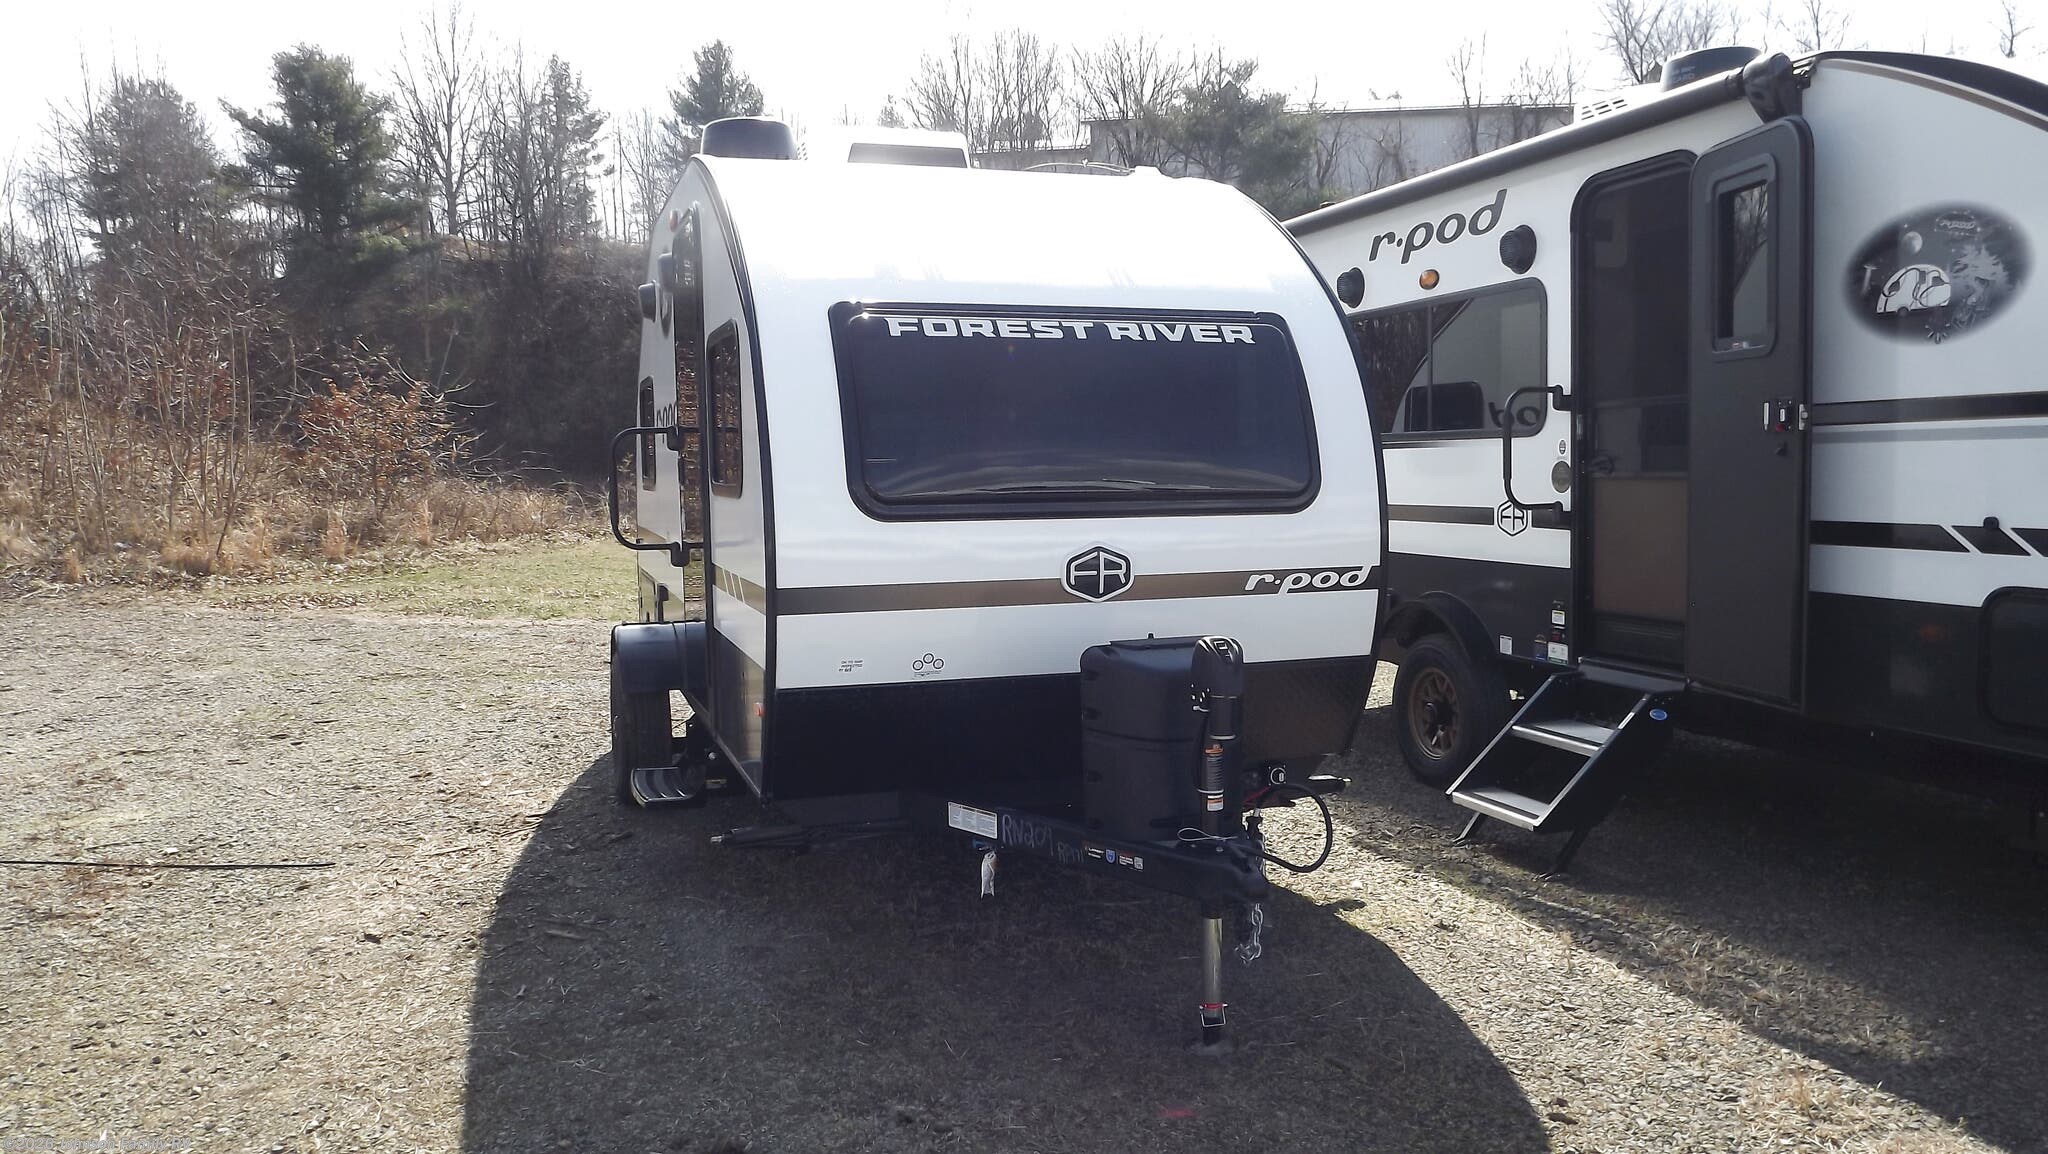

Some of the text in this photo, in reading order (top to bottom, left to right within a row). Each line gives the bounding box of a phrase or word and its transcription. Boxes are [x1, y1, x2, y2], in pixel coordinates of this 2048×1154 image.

[884, 317, 1256, 344] FOREST RIVER
[1068, 549, 1129, 597] FR
